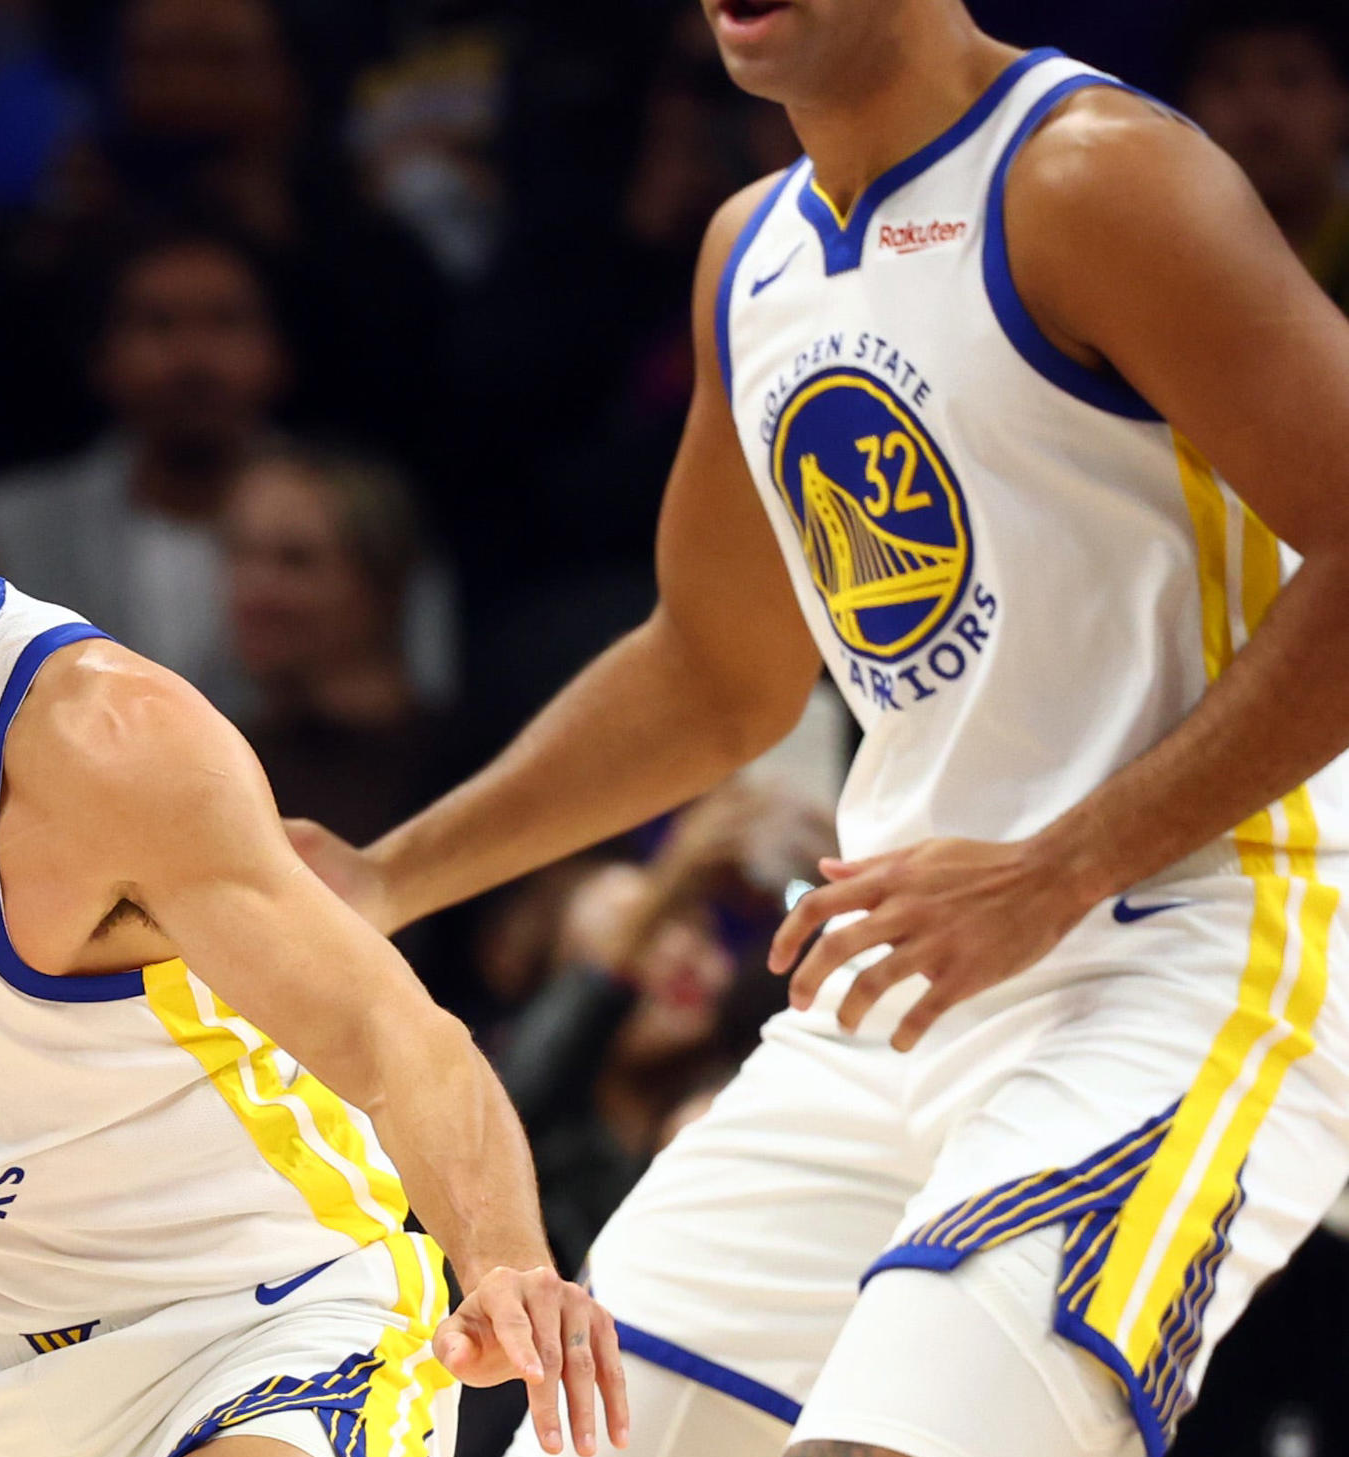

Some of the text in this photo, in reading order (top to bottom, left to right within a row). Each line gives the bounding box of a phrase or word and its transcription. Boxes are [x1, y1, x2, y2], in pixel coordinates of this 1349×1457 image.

[879, 219, 966, 249] Rakuten
[854, 332, 931, 407] STATE
[855, 431, 931, 518] 32
